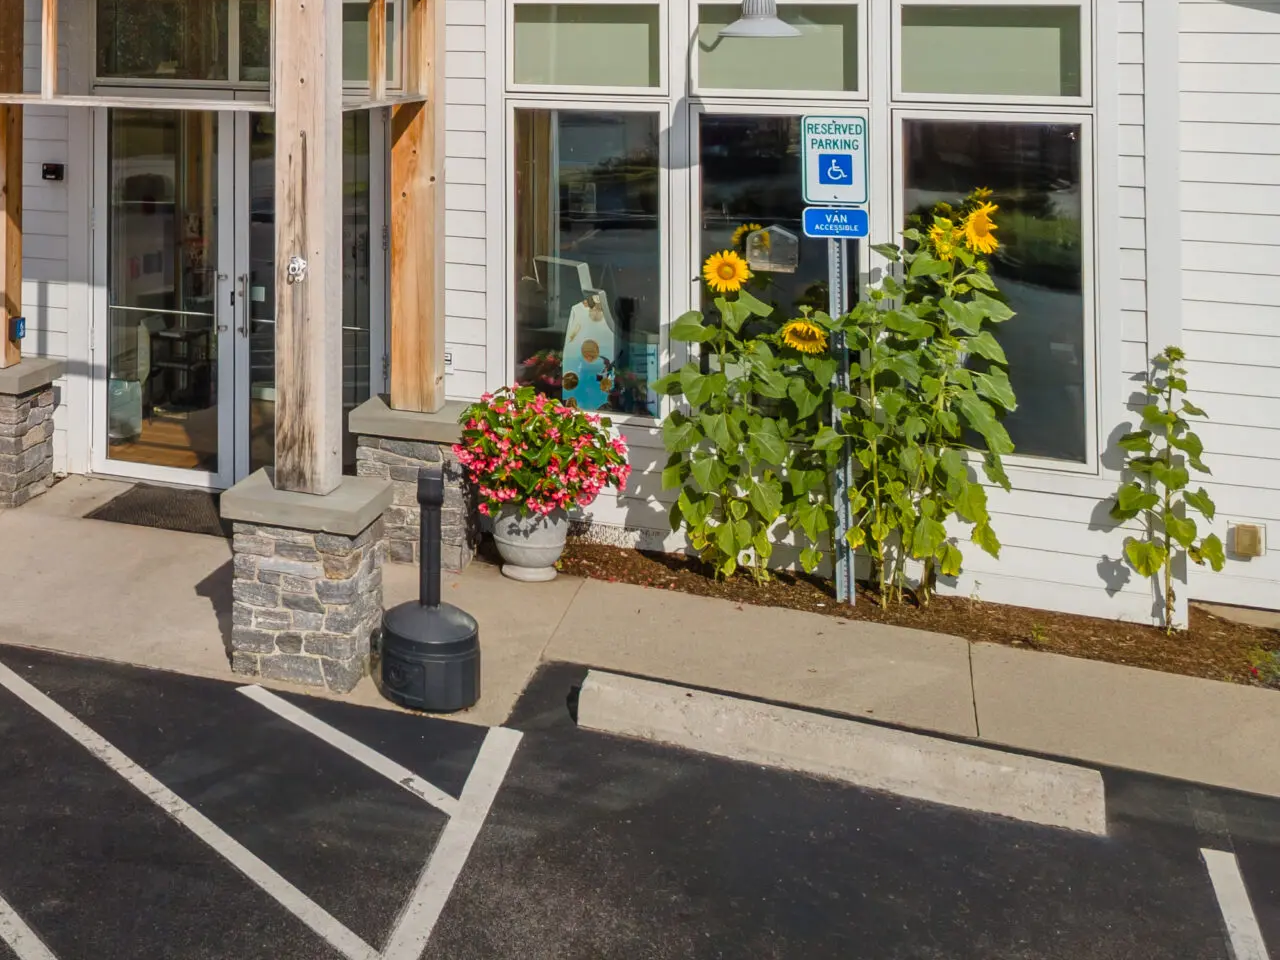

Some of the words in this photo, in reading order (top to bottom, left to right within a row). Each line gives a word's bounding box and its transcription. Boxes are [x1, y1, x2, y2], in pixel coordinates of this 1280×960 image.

[807, 123, 863, 136] RESERVED
[811, 138, 859, 151] PARKING
[825, 214, 848, 224] VAN
[814, 224, 859, 232] ACCESSIBLE
